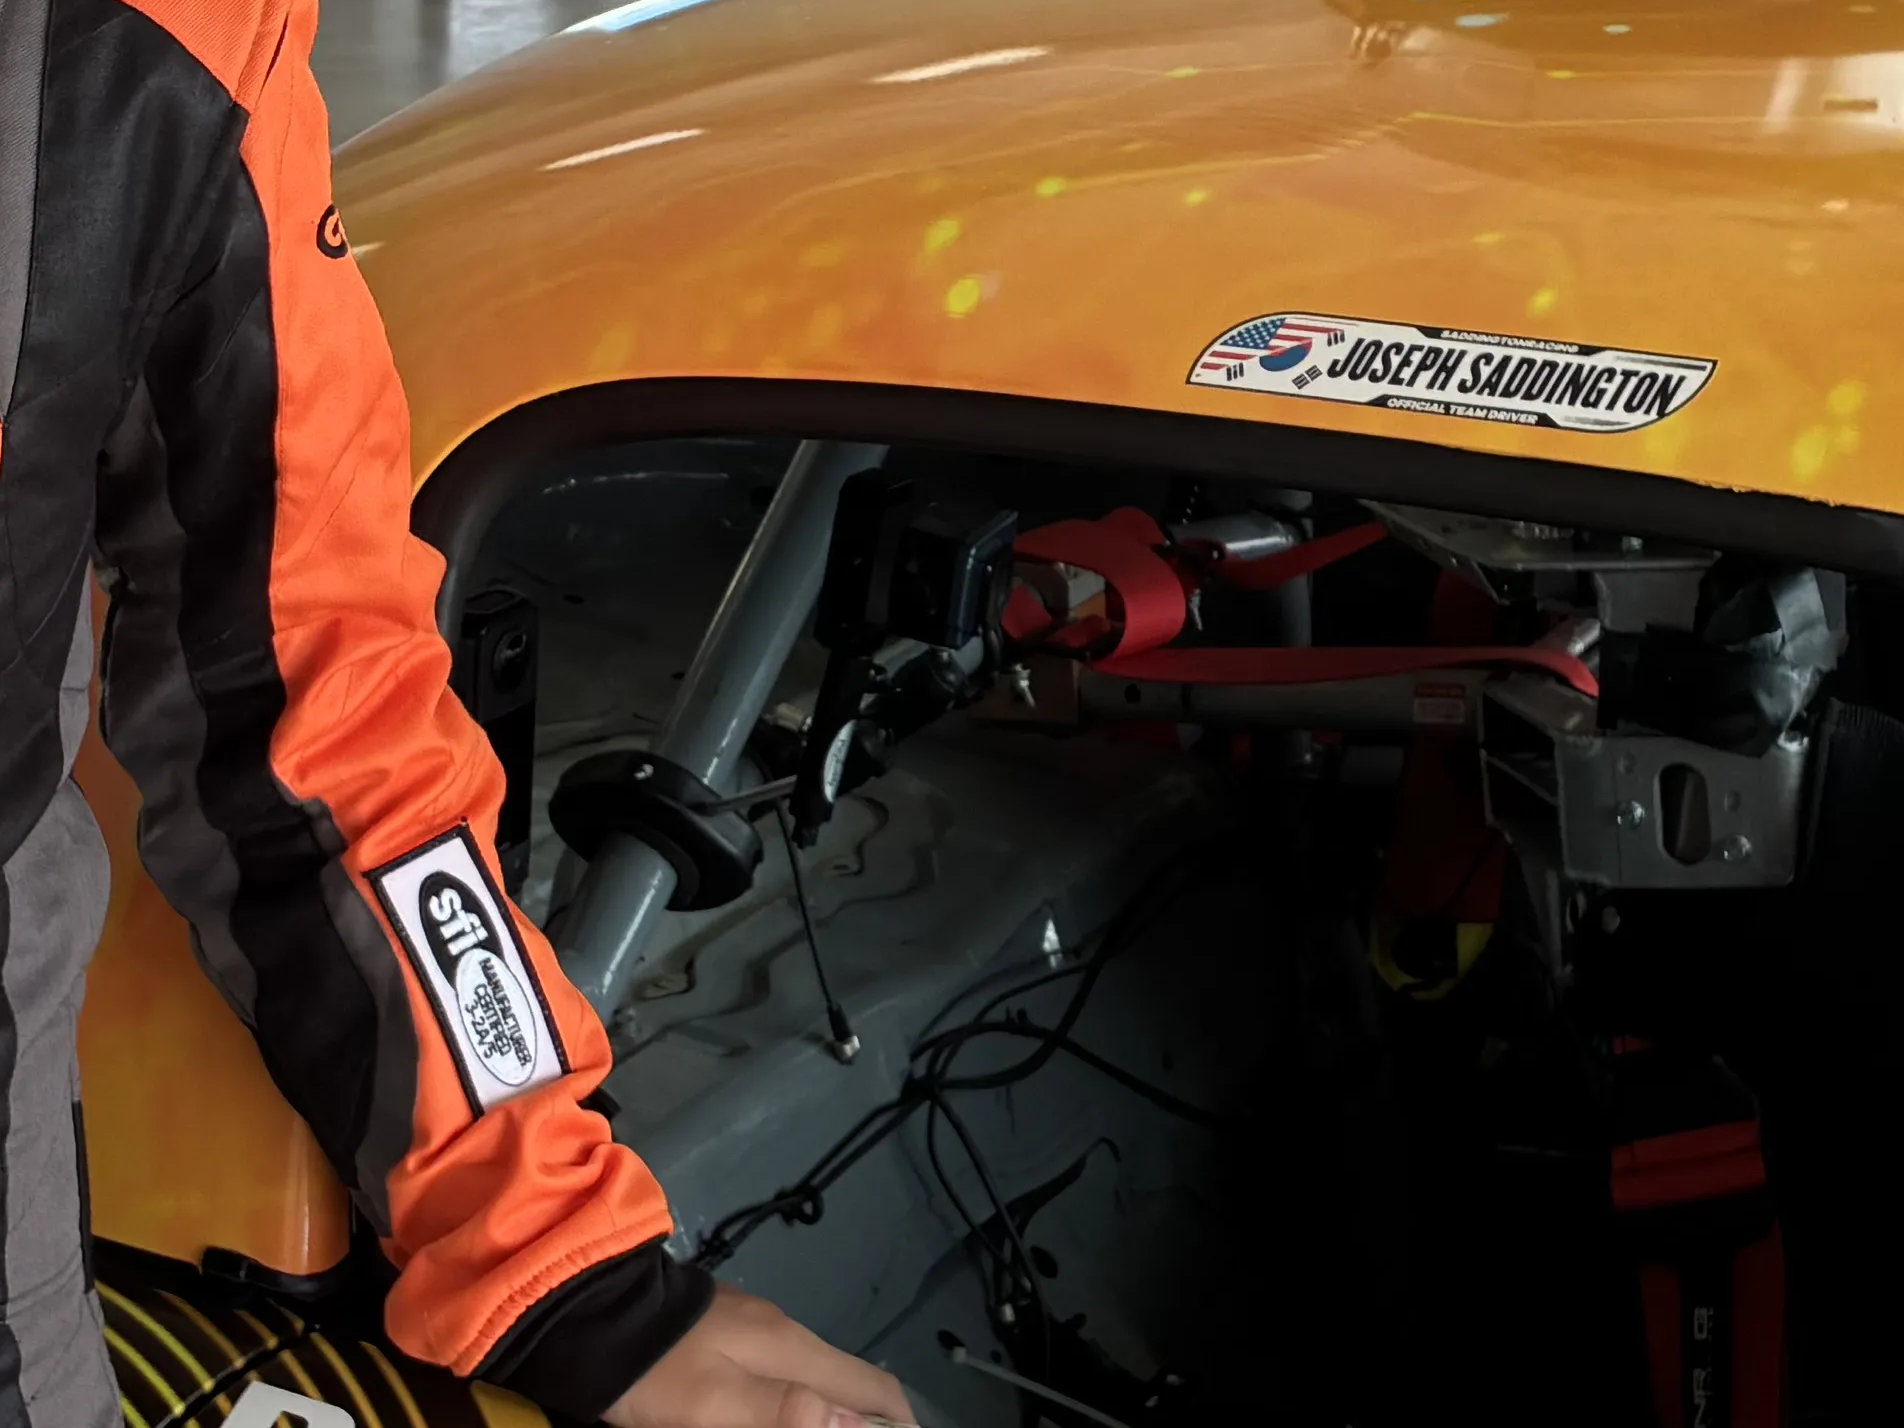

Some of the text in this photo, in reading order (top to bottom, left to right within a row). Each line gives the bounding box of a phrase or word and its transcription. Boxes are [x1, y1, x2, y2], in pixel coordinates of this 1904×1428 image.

[1327, 337, 1687, 418] JOSEPH SADDINGTON
[1386, 397, 1538, 424] OFFICIAL TEAM DRIVER
[475, 983, 512, 1057] CERTIFIED
[479, 957, 533, 1067] MANUFACTURER
